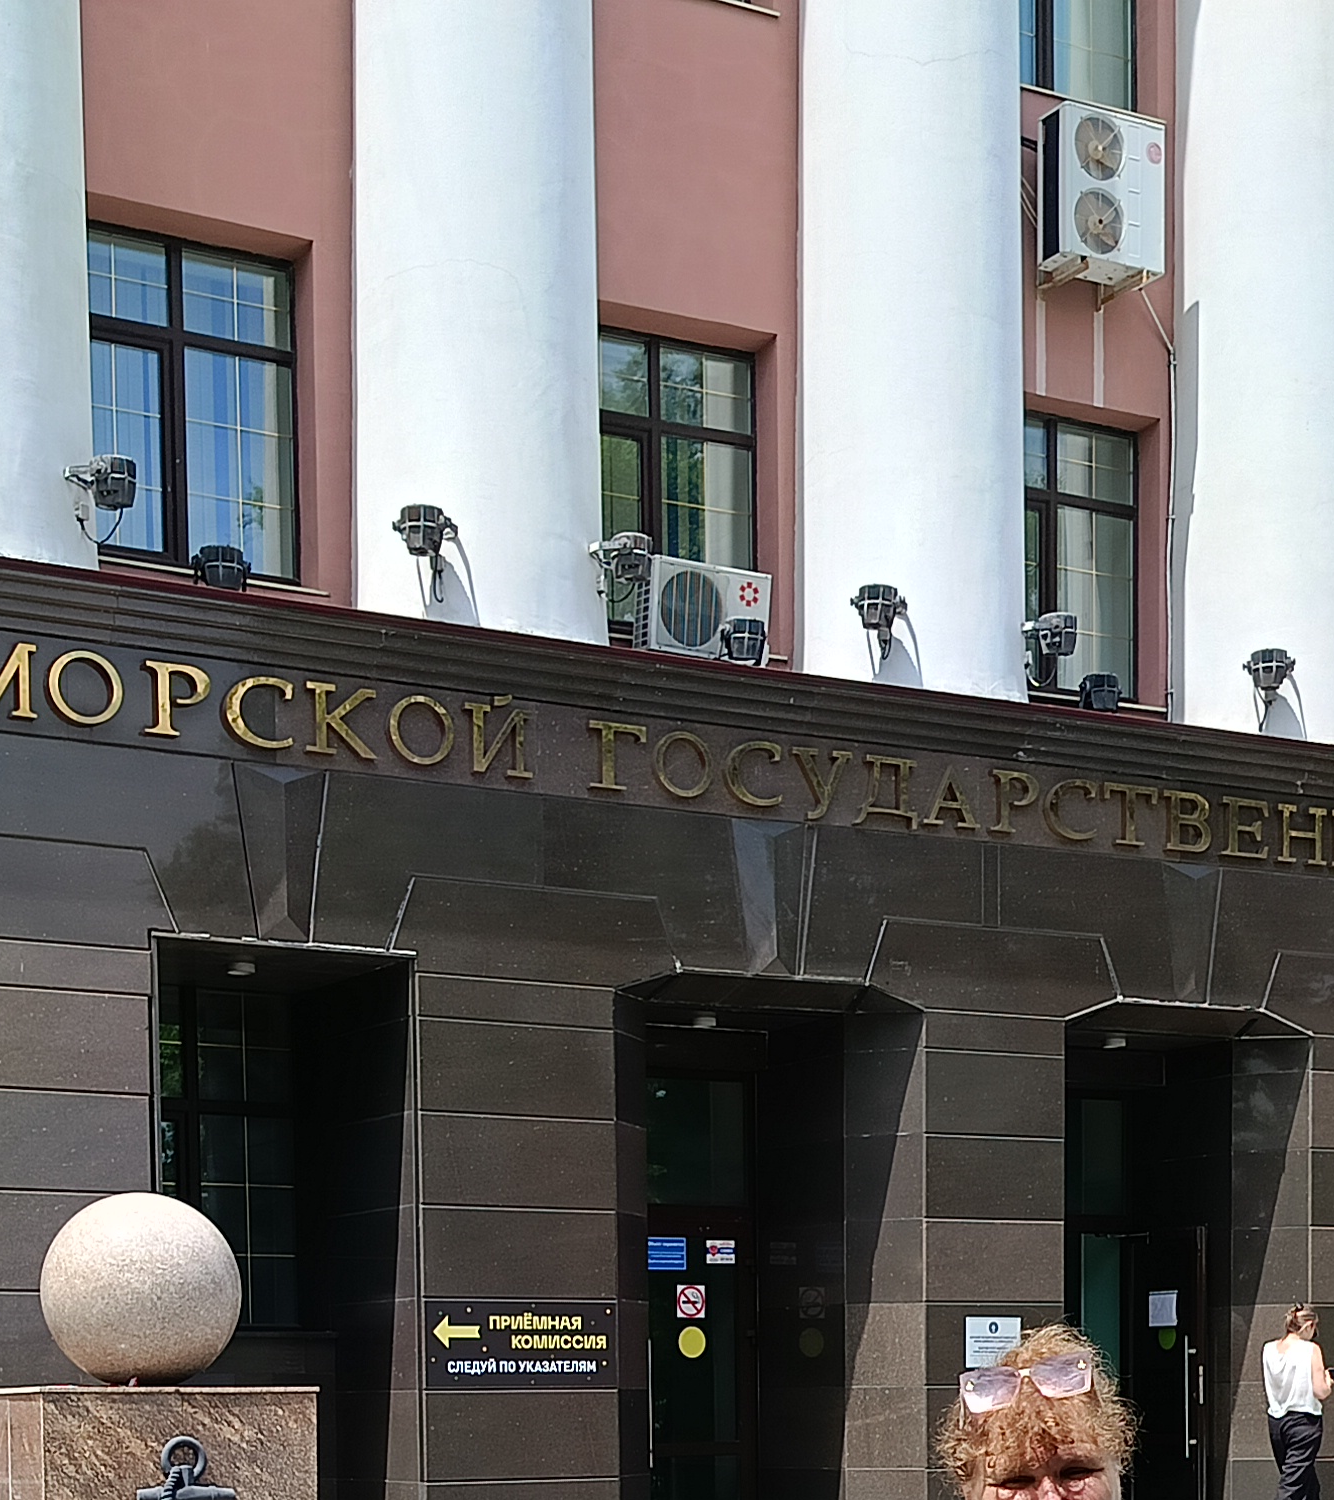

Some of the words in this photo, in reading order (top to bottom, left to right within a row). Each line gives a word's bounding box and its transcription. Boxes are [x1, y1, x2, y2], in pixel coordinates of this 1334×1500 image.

[488, 1312, 582, 1330] ПРИЁМНАЯ
[510, 1335, 607, 1349] КОМИССИЯ
[447, 1358, 496, 1375] СЛЕДУЙ
[499, 1361, 516, 1373] ПО
[519, 1361, 597, 1373] УКАЗАТЕЛЯМ
